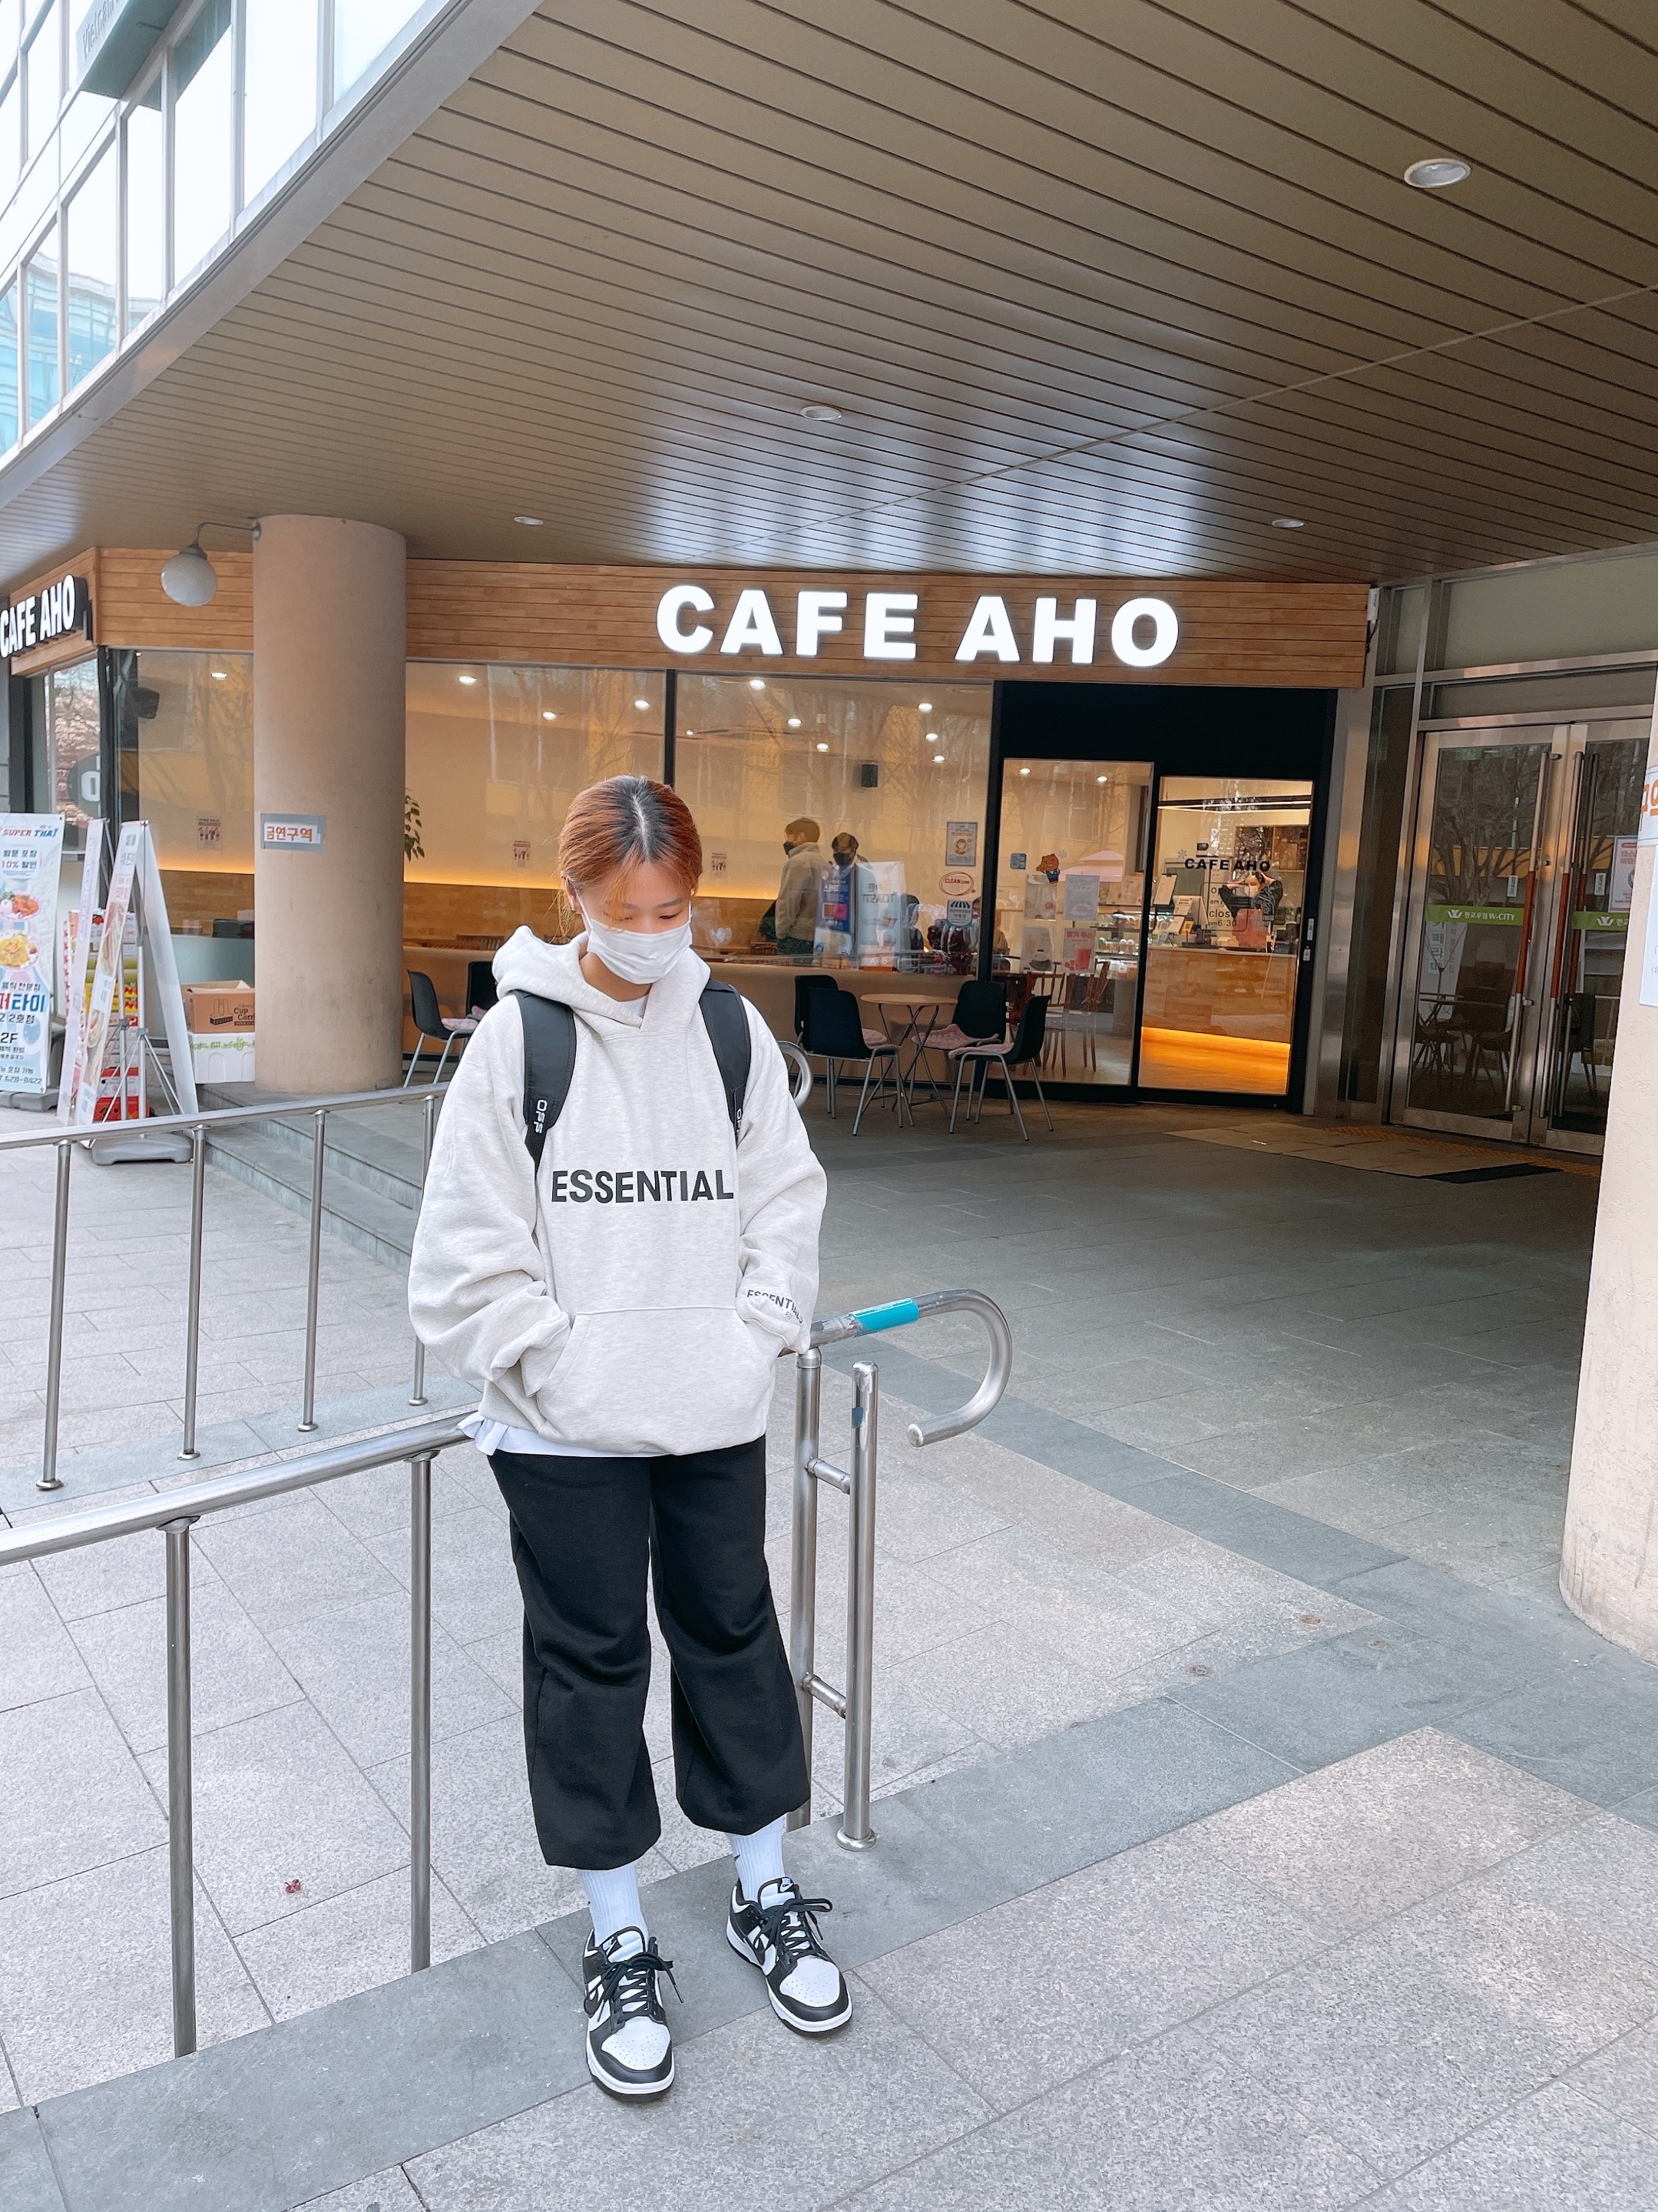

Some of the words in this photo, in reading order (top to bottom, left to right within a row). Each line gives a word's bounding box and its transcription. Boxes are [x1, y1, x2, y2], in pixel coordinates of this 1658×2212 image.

[0, 595, 36, 658] CAFE
[40, 575, 75, 641] AHO
[657, 584, 918, 659] CAFE
[955, 595, 1180, 667] AHO
[266, 826, 313, 843] 금연구역
[2, 860, 20, 869] 10%
[1184, 858, 1229, 870] CAFE
[1233, 859, 1271, 872] AHO
[1209, 909, 1235, 918] clos
[233, 1007, 249, 1015] Cup
[1, 1032, 19, 1044] 2F
[551, 1169, 734, 1204] ESSENTIAL
